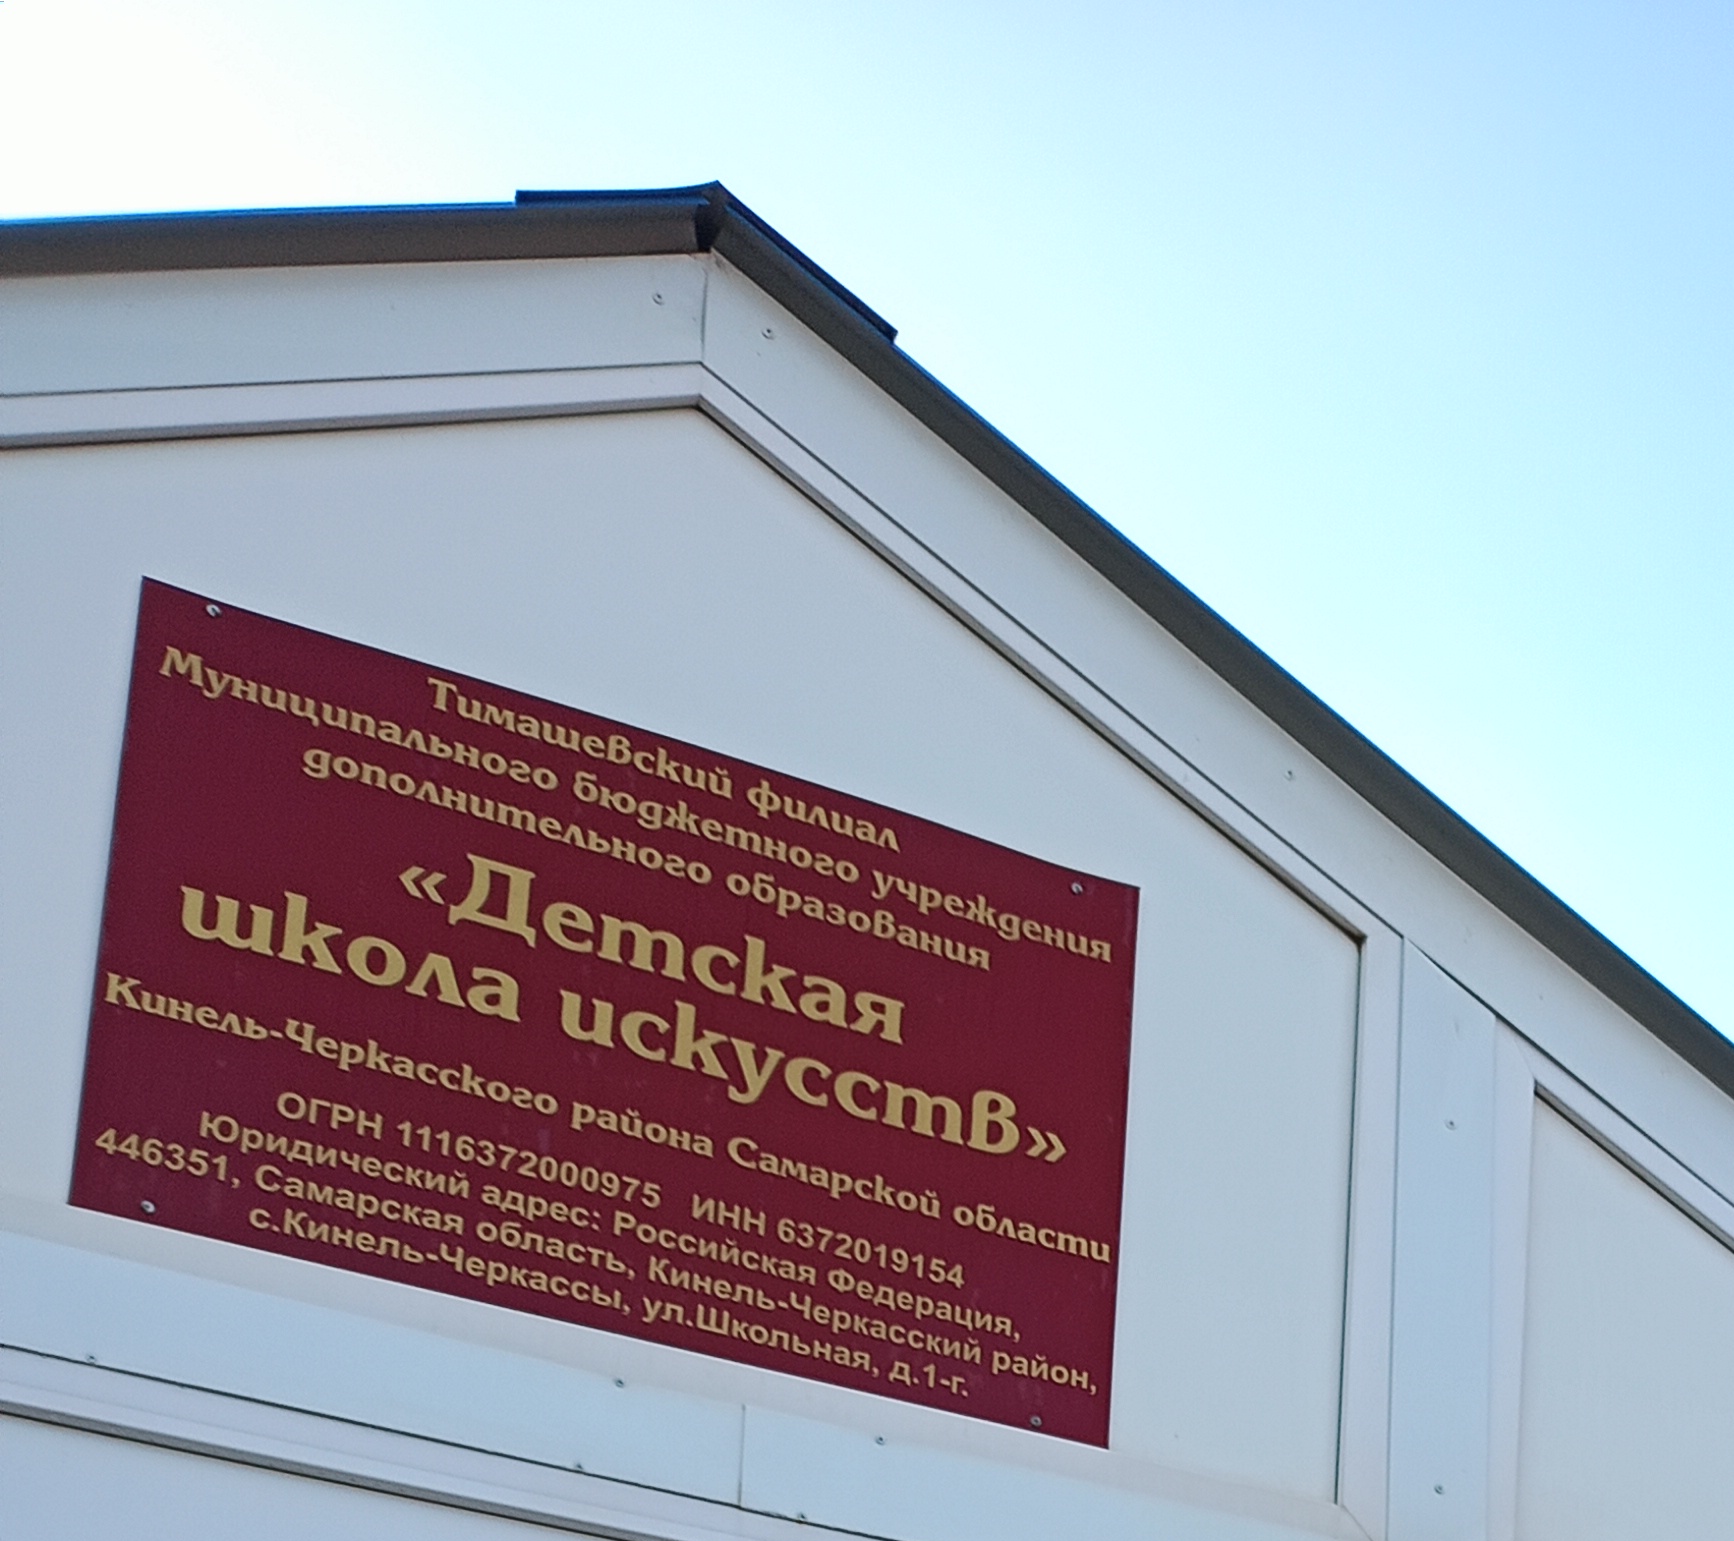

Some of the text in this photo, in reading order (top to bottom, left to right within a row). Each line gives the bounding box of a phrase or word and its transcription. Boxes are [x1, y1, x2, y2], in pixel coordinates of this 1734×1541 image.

[158, 644, 1112, 964] Муниципального бюджетного учреждения
[301, 748, 991, 972] дополнительного образования
[426, 676, 901, 854] Тимашевский филиал
[179, 884, 1068, 1164] школа искусств»
[397, 852, 906, 1046] «Детская
[104, 971, 1111, 1264] Кинель-Черкасского района Самарской области
[198, 1110, 1021, 1344] Юридический адрес: Российская Федерация,
[276, 1091, 966, 1290] ОГРН 1116372000975 ИНН 6372019154
[94, 1127, 1098, 1396] 446351, Самарская область, Кинель-Черкасский район,
[248, 1207, 969, 1398] с.Кинель-Черкассы, ул.Школьная, д.1-г.
